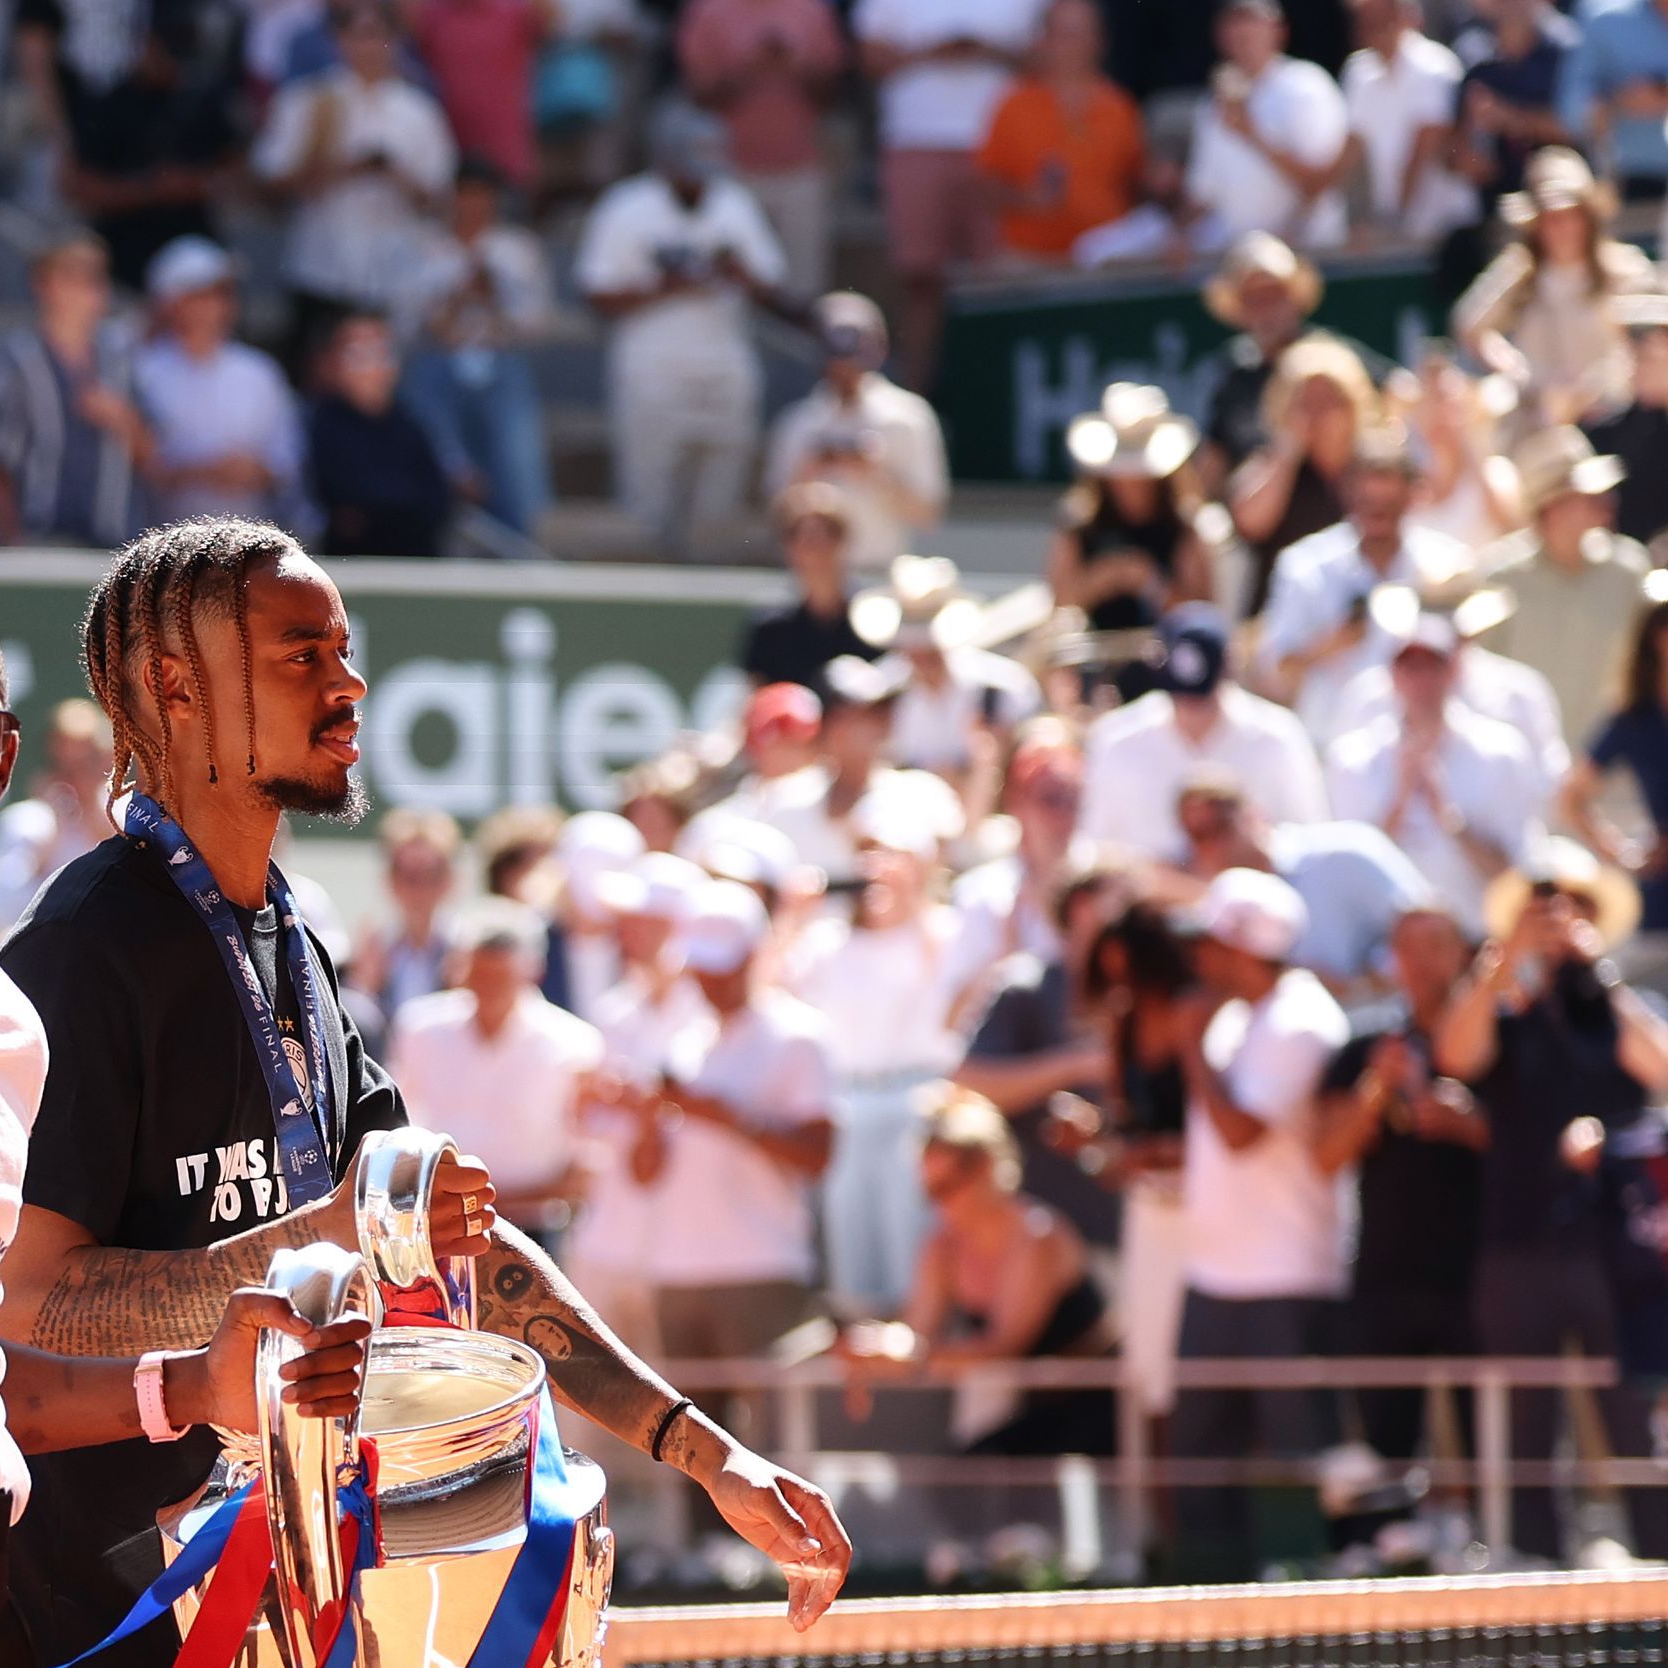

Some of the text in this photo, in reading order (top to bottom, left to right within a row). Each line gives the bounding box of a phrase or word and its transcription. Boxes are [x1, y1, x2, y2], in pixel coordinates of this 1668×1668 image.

[127, 803, 159, 833] FINAL
[299, 957, 315, 1010] FINAL
[259, 1015, 282, 1074] FINAL
[175, 1152, 209, 1197] IT
